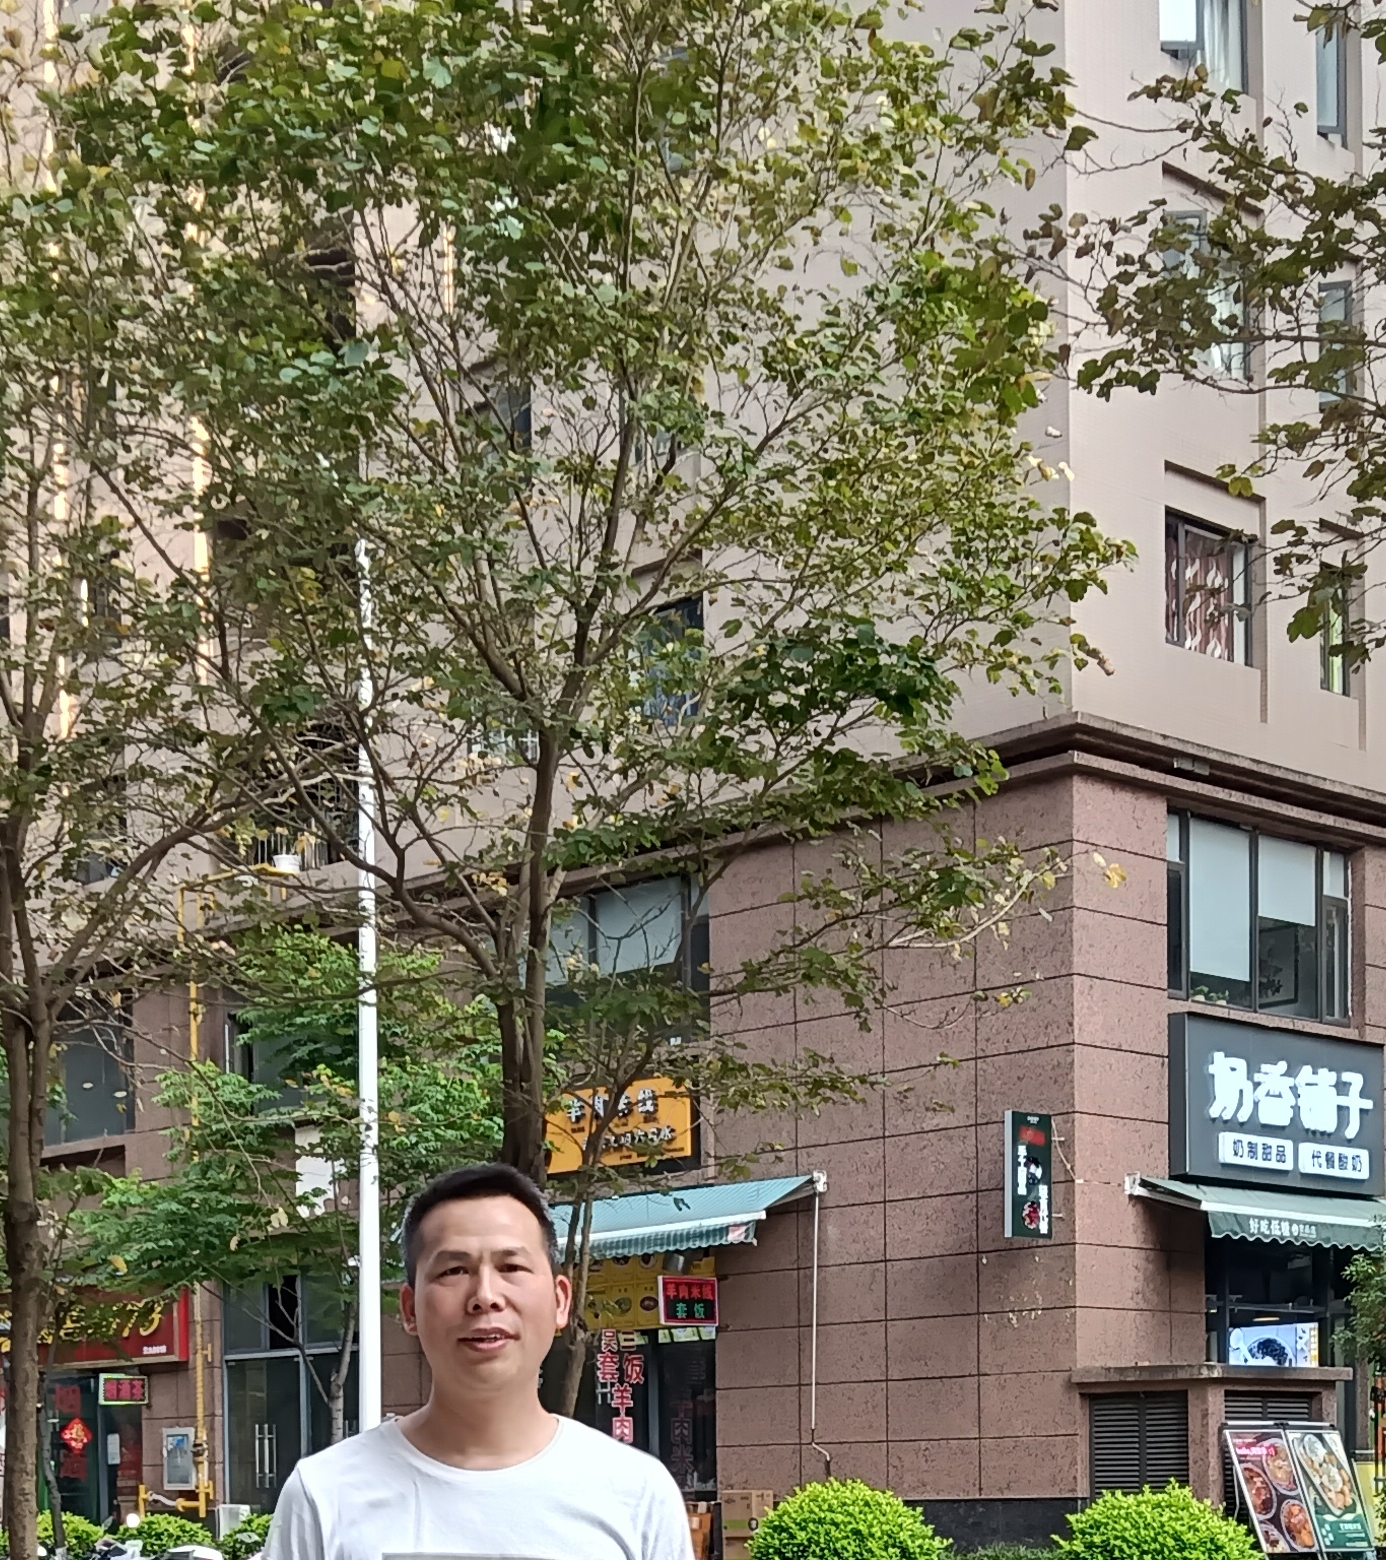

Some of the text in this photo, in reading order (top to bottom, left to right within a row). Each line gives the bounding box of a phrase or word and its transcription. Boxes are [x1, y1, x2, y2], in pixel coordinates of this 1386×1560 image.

[1232, 1138, 1287, 1164] 奶制甜品
[1311, 1149, 1363, 1173] 代餐酸奶
[665, 1283, 714, 1300] 羊肉米线
[675, 1302, 706, 1320] 套饭
[597, 1352, 645, 1385] 套饭
